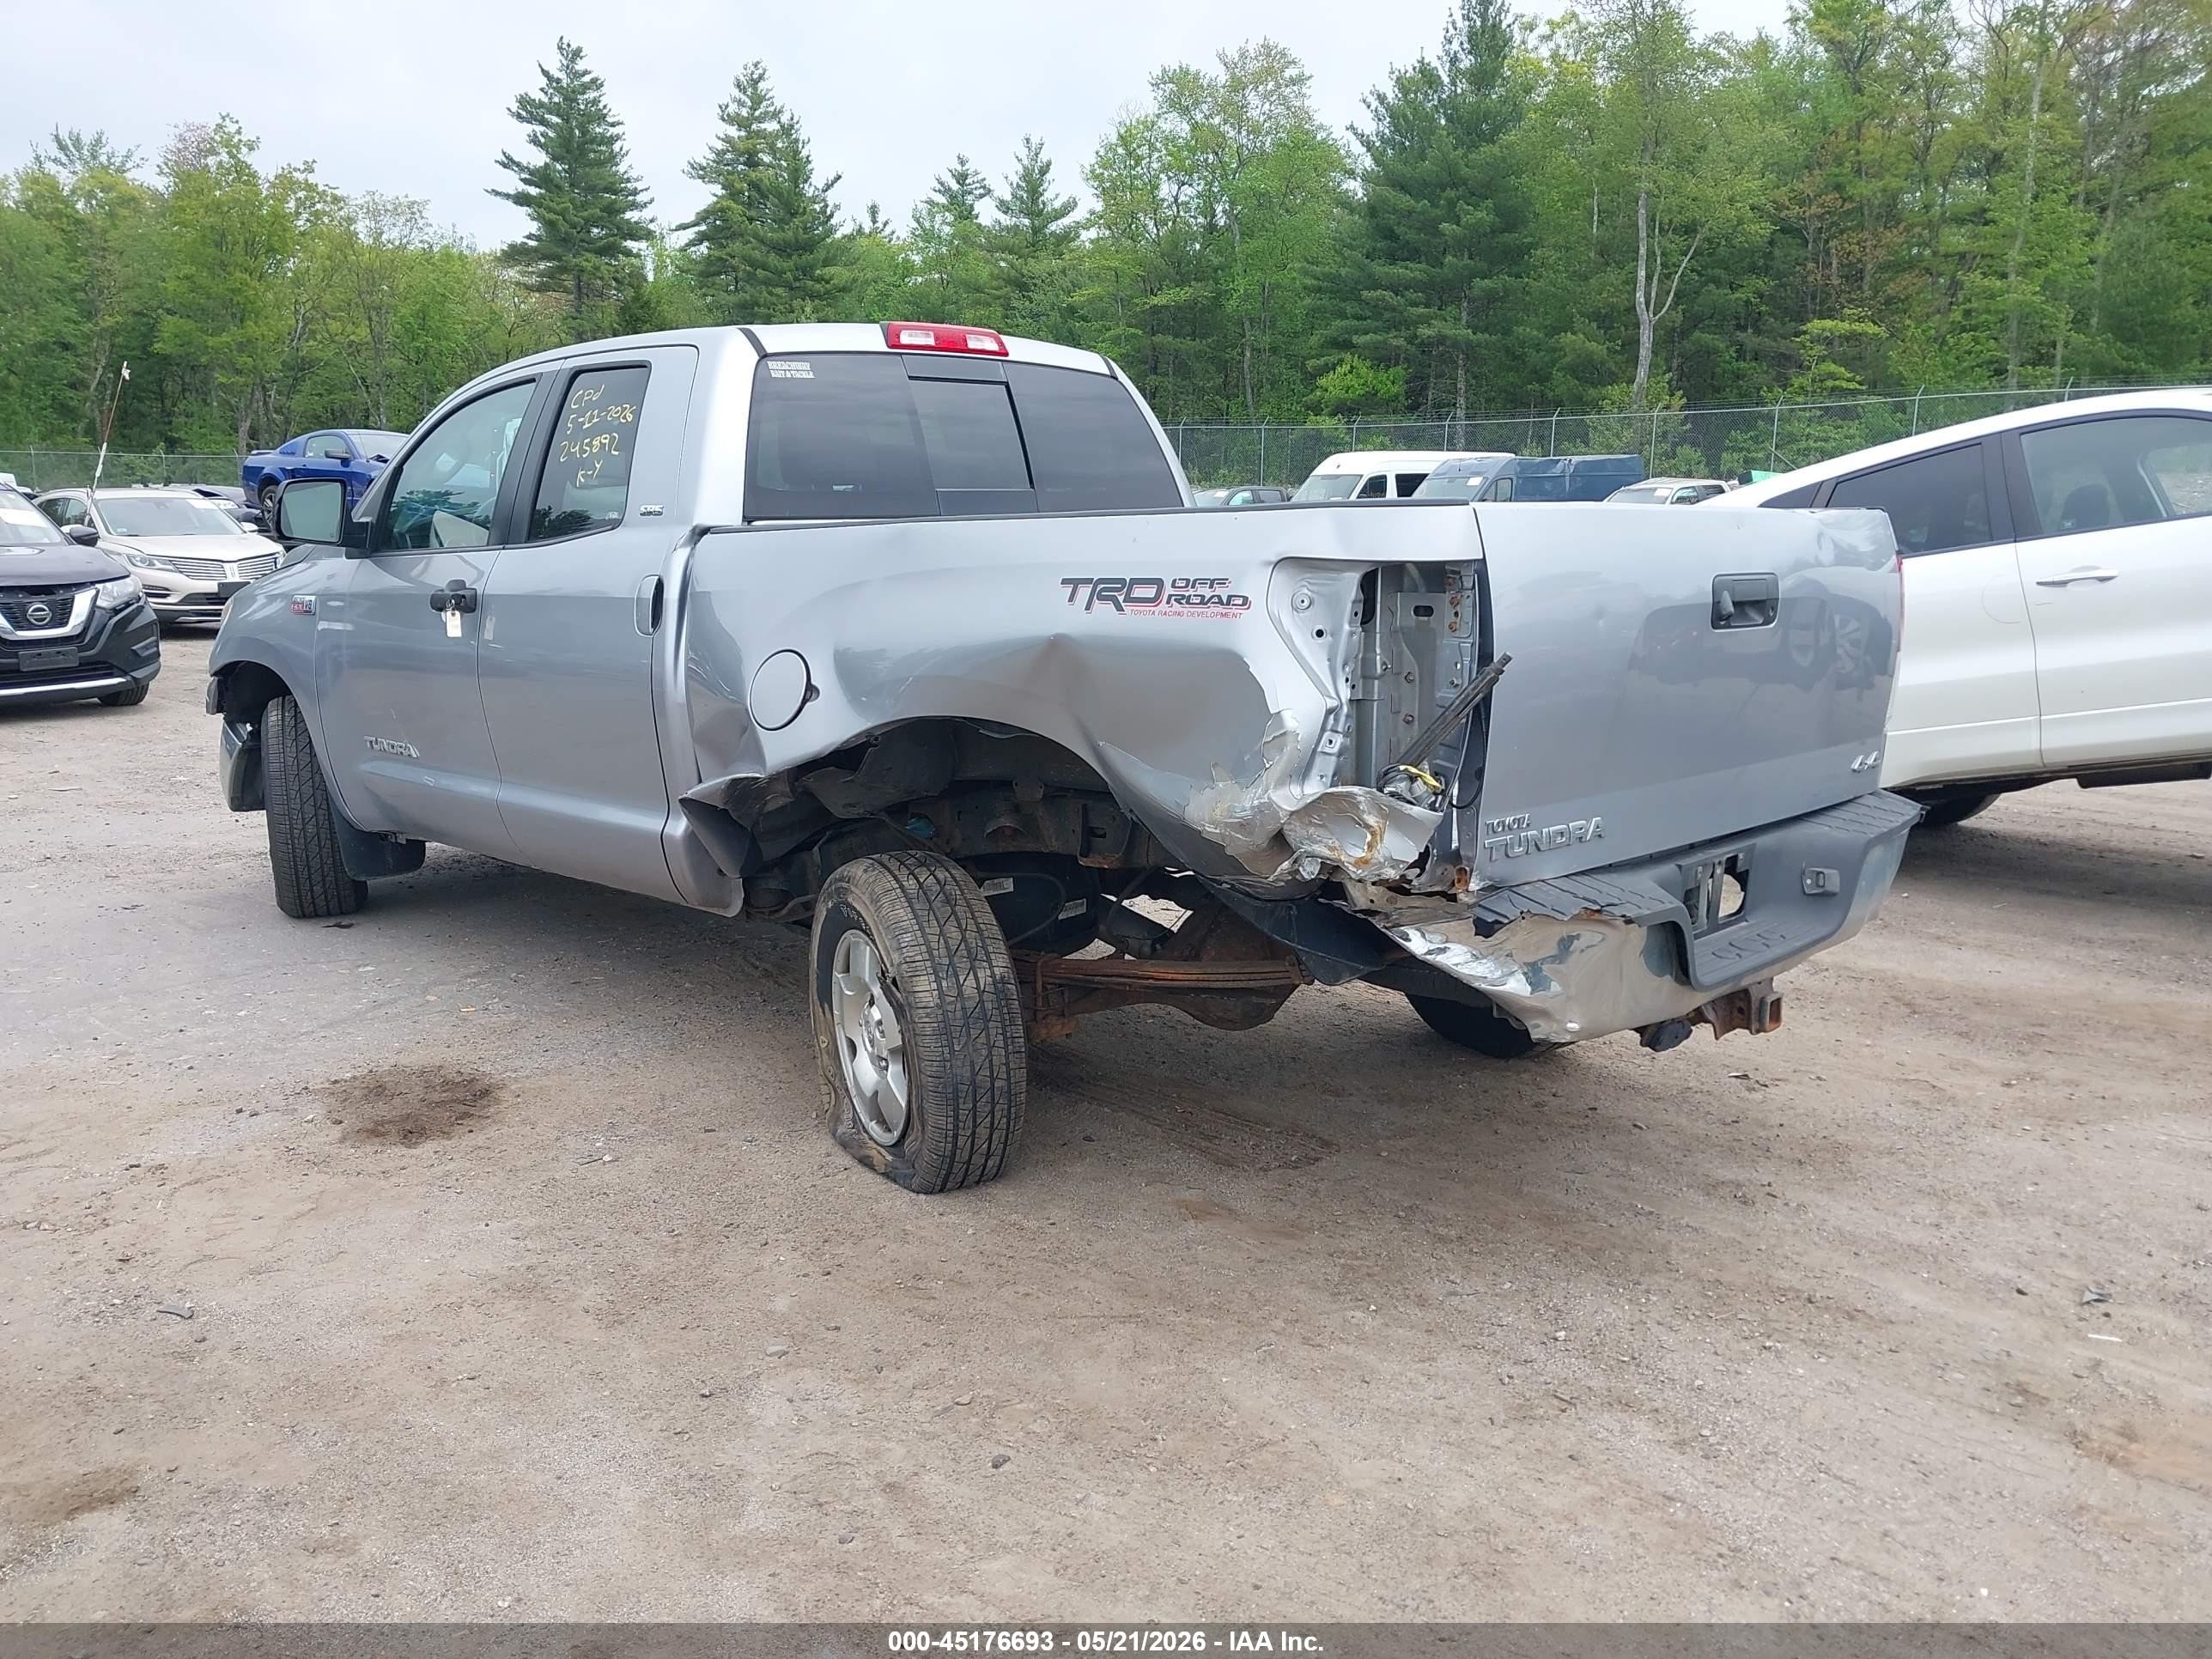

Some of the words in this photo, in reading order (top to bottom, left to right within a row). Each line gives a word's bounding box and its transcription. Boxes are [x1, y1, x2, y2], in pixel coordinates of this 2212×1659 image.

[560, 433, 618, 462] 245892
[1170, 578, 1231, 592] OFF
[1060, 578, 1166, 615] TRD
[1166, 593, 1251, 610] ROAD
[1186, 611, 1243, 619] DEVELOPMENT
[364, 736, 420, 757] TUNDRA
[1486, 813, 1530, 835] TOYOTA
[1484, 817, 1604, 861] TUNDRA
